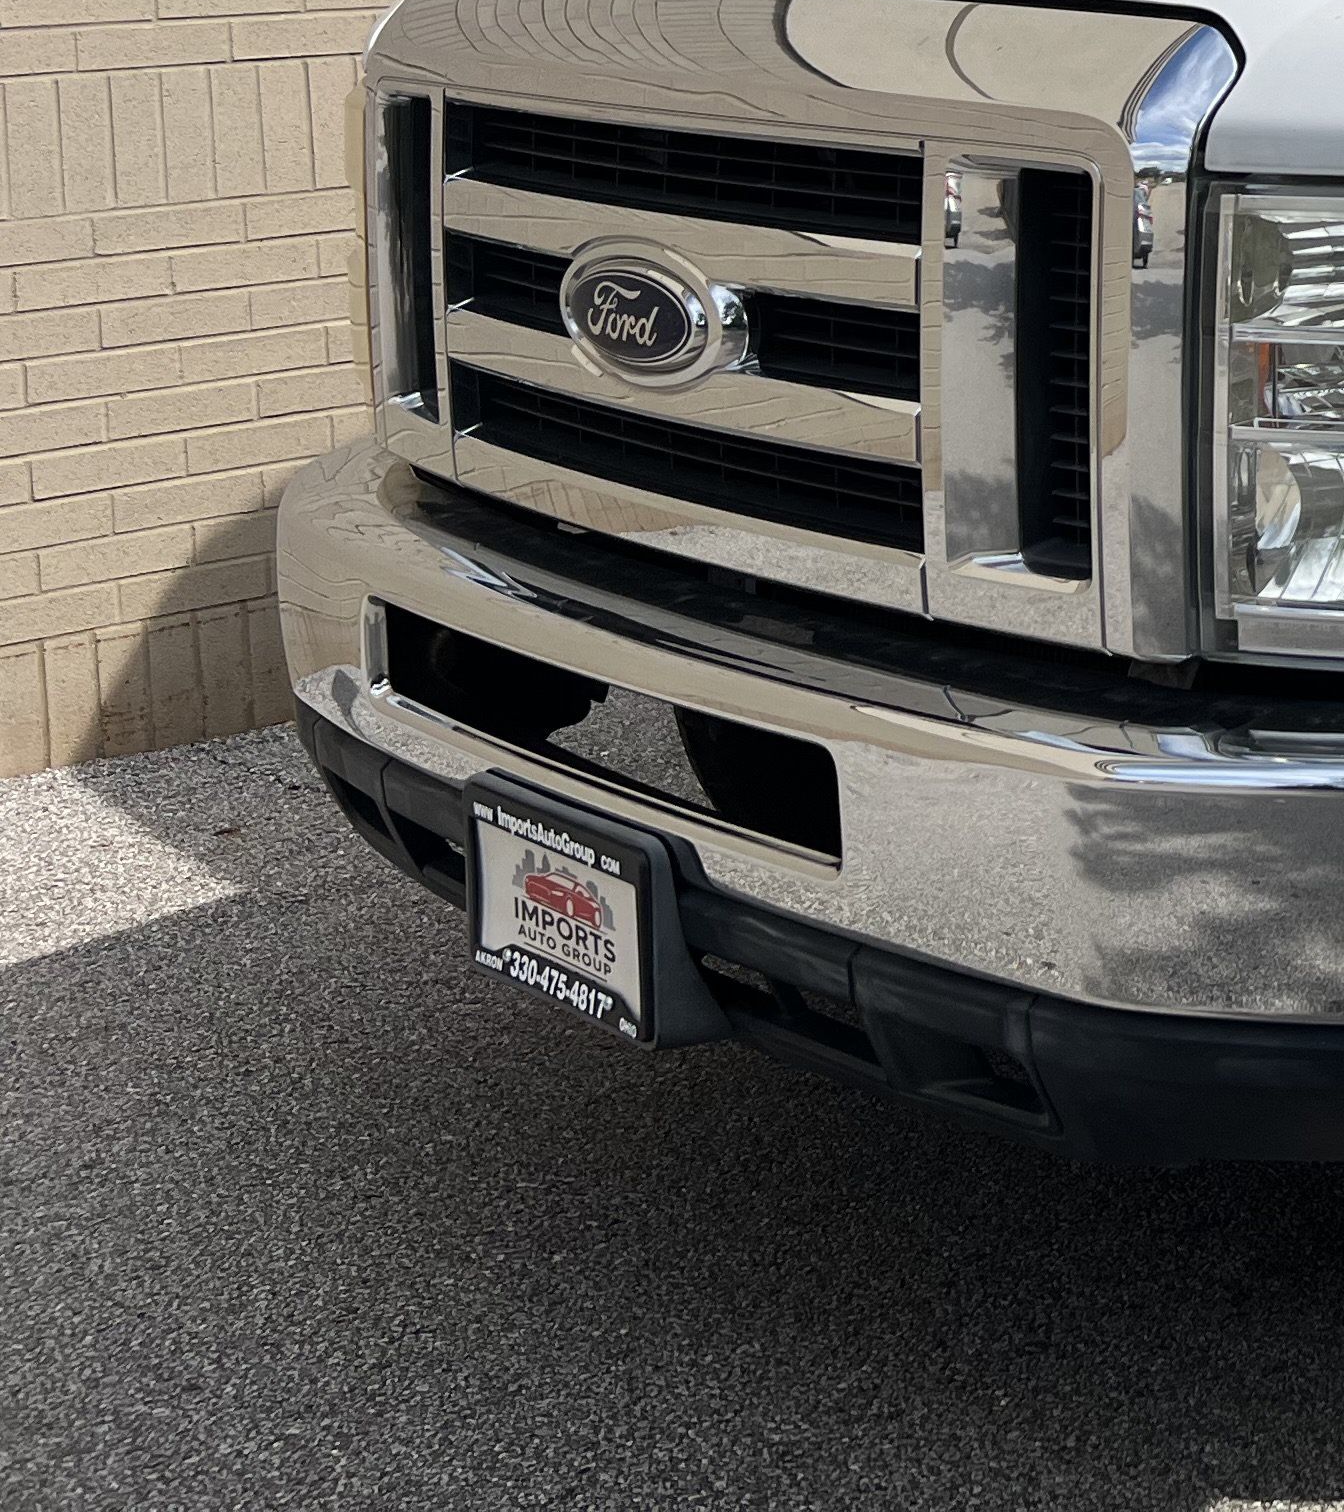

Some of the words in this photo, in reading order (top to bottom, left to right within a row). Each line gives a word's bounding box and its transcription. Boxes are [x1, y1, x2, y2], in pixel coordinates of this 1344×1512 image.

[587, 280, 660, 347] Ford
[513, 896, 616, 963] IMPORTS
[518, 923, 557, 951] AUTO
[561, 943, 613, 976] GROUP
[475, 950, 503, 971] AKRON
